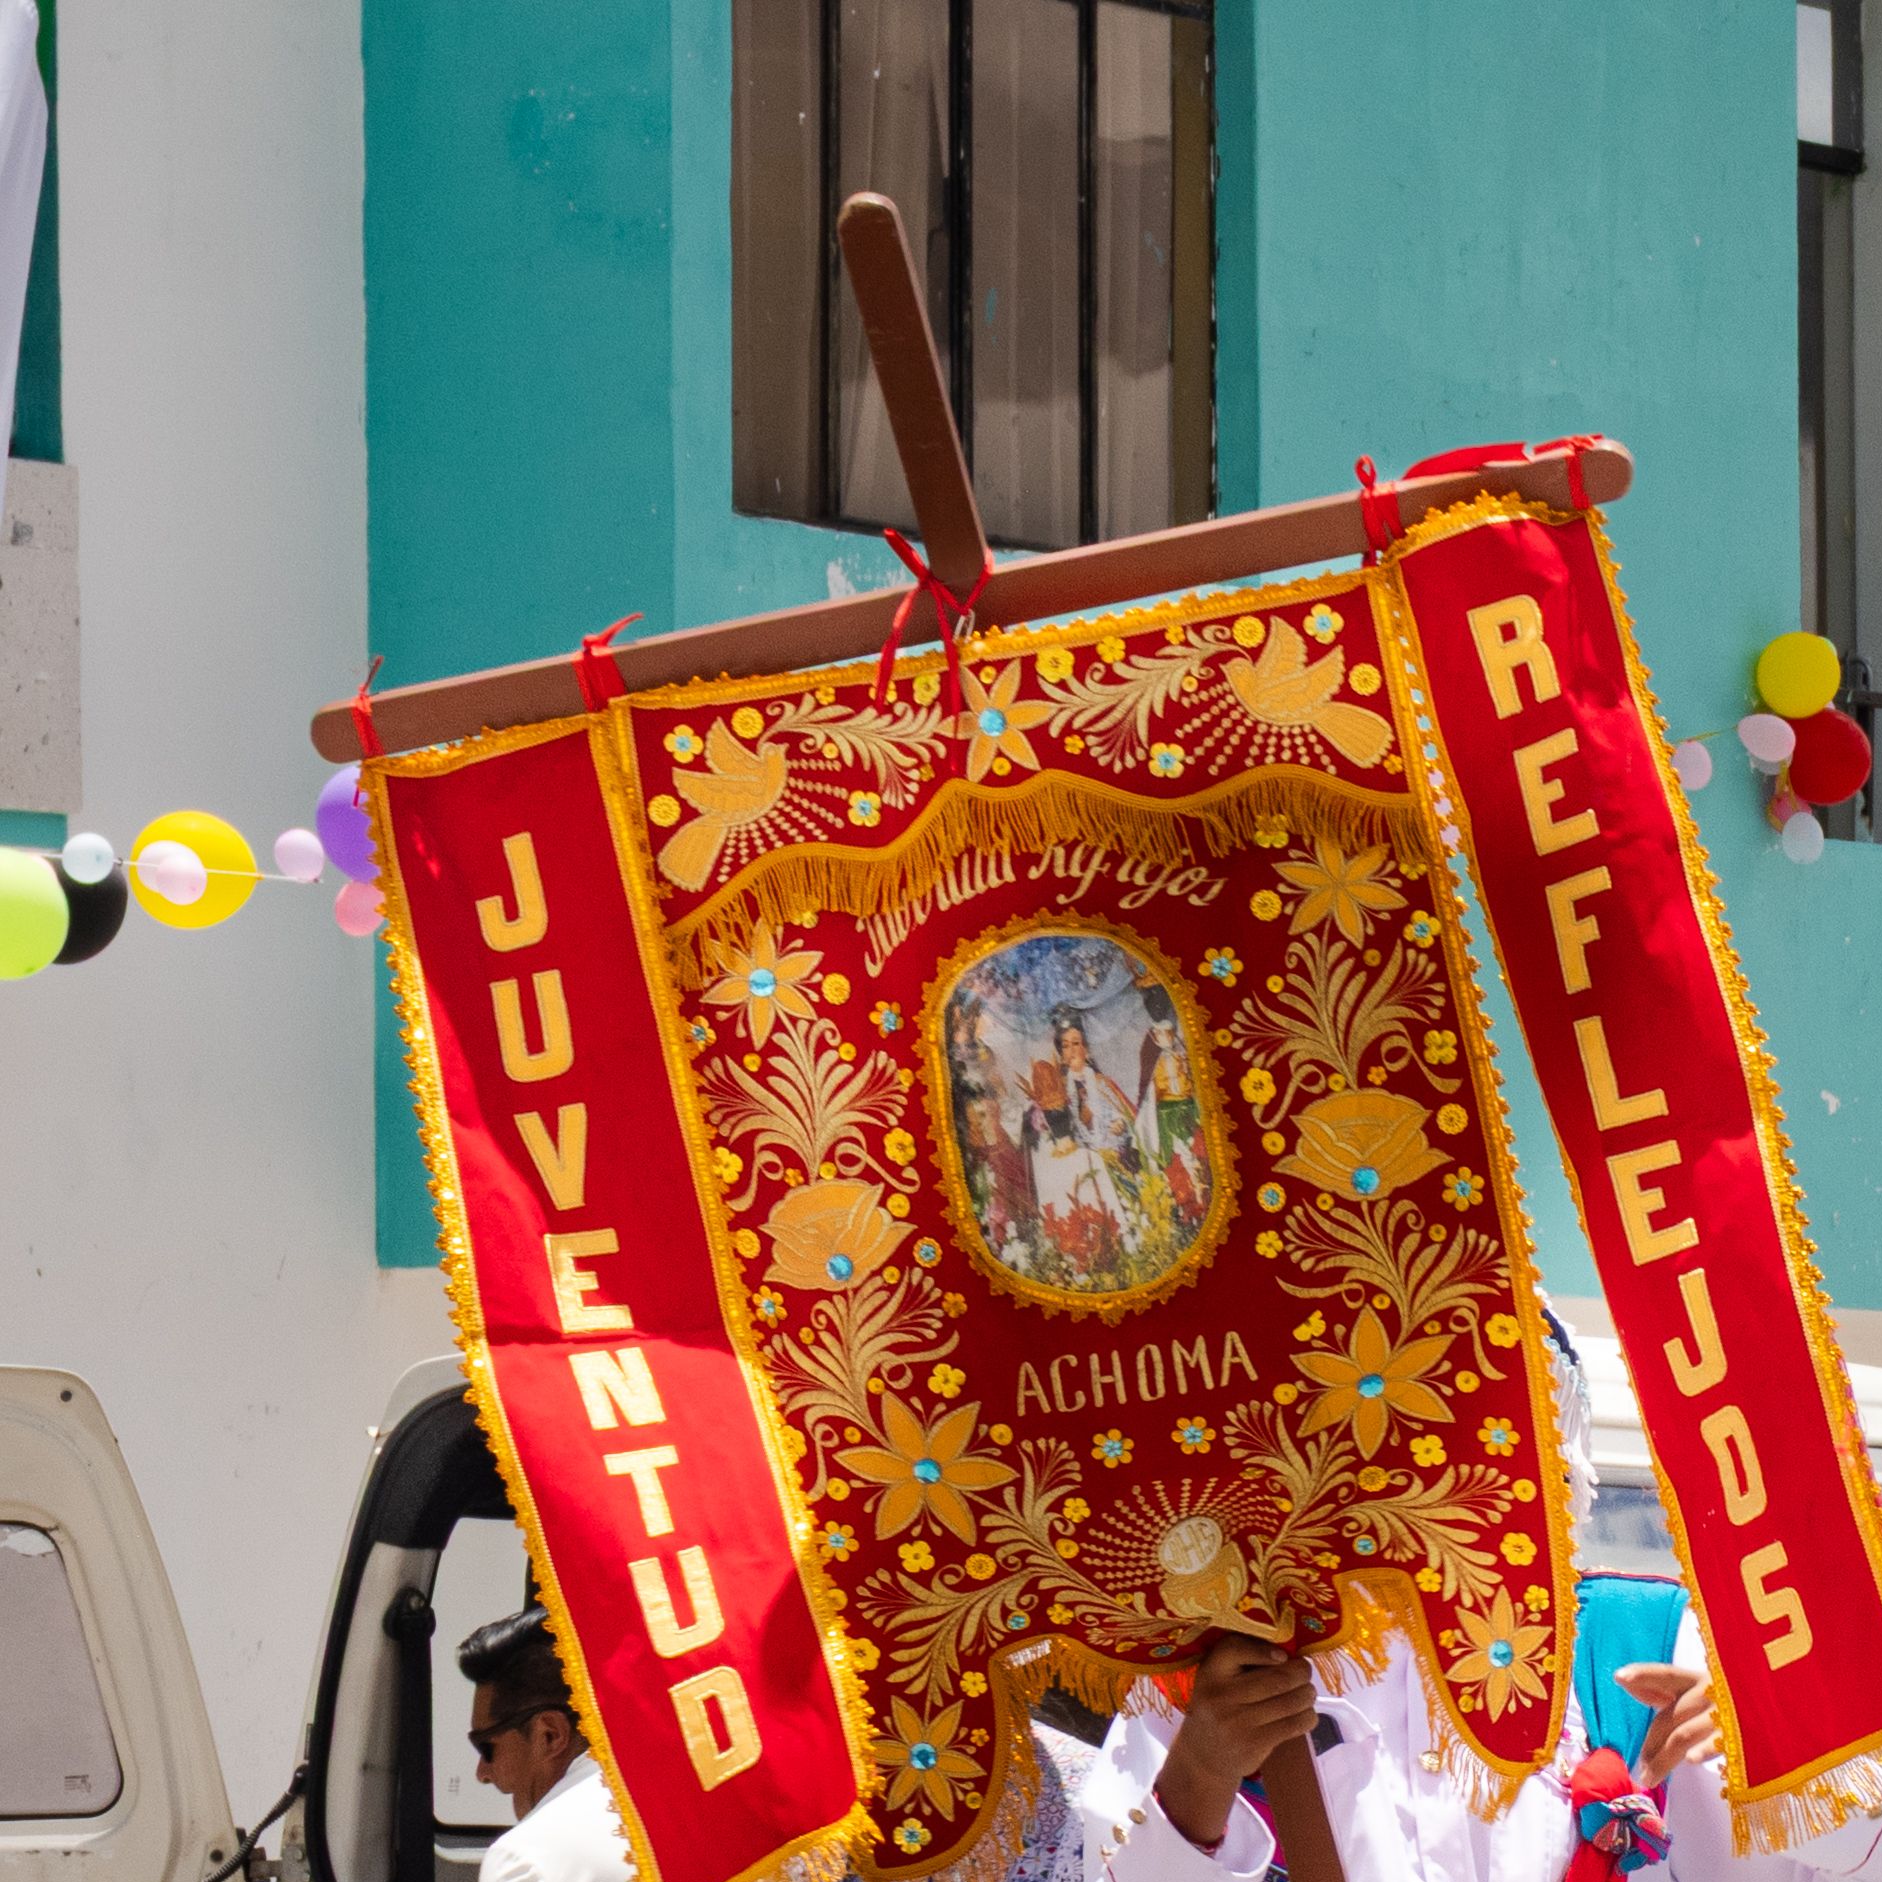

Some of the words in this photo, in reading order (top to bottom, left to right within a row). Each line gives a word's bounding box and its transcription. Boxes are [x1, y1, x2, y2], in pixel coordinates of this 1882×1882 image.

[476, 832, 763, 1792] JUVENTUD
[1016, 1330, 1258, 1416] ACHOMA
[1465, 593, 1813, 1670] REFLEJOS
